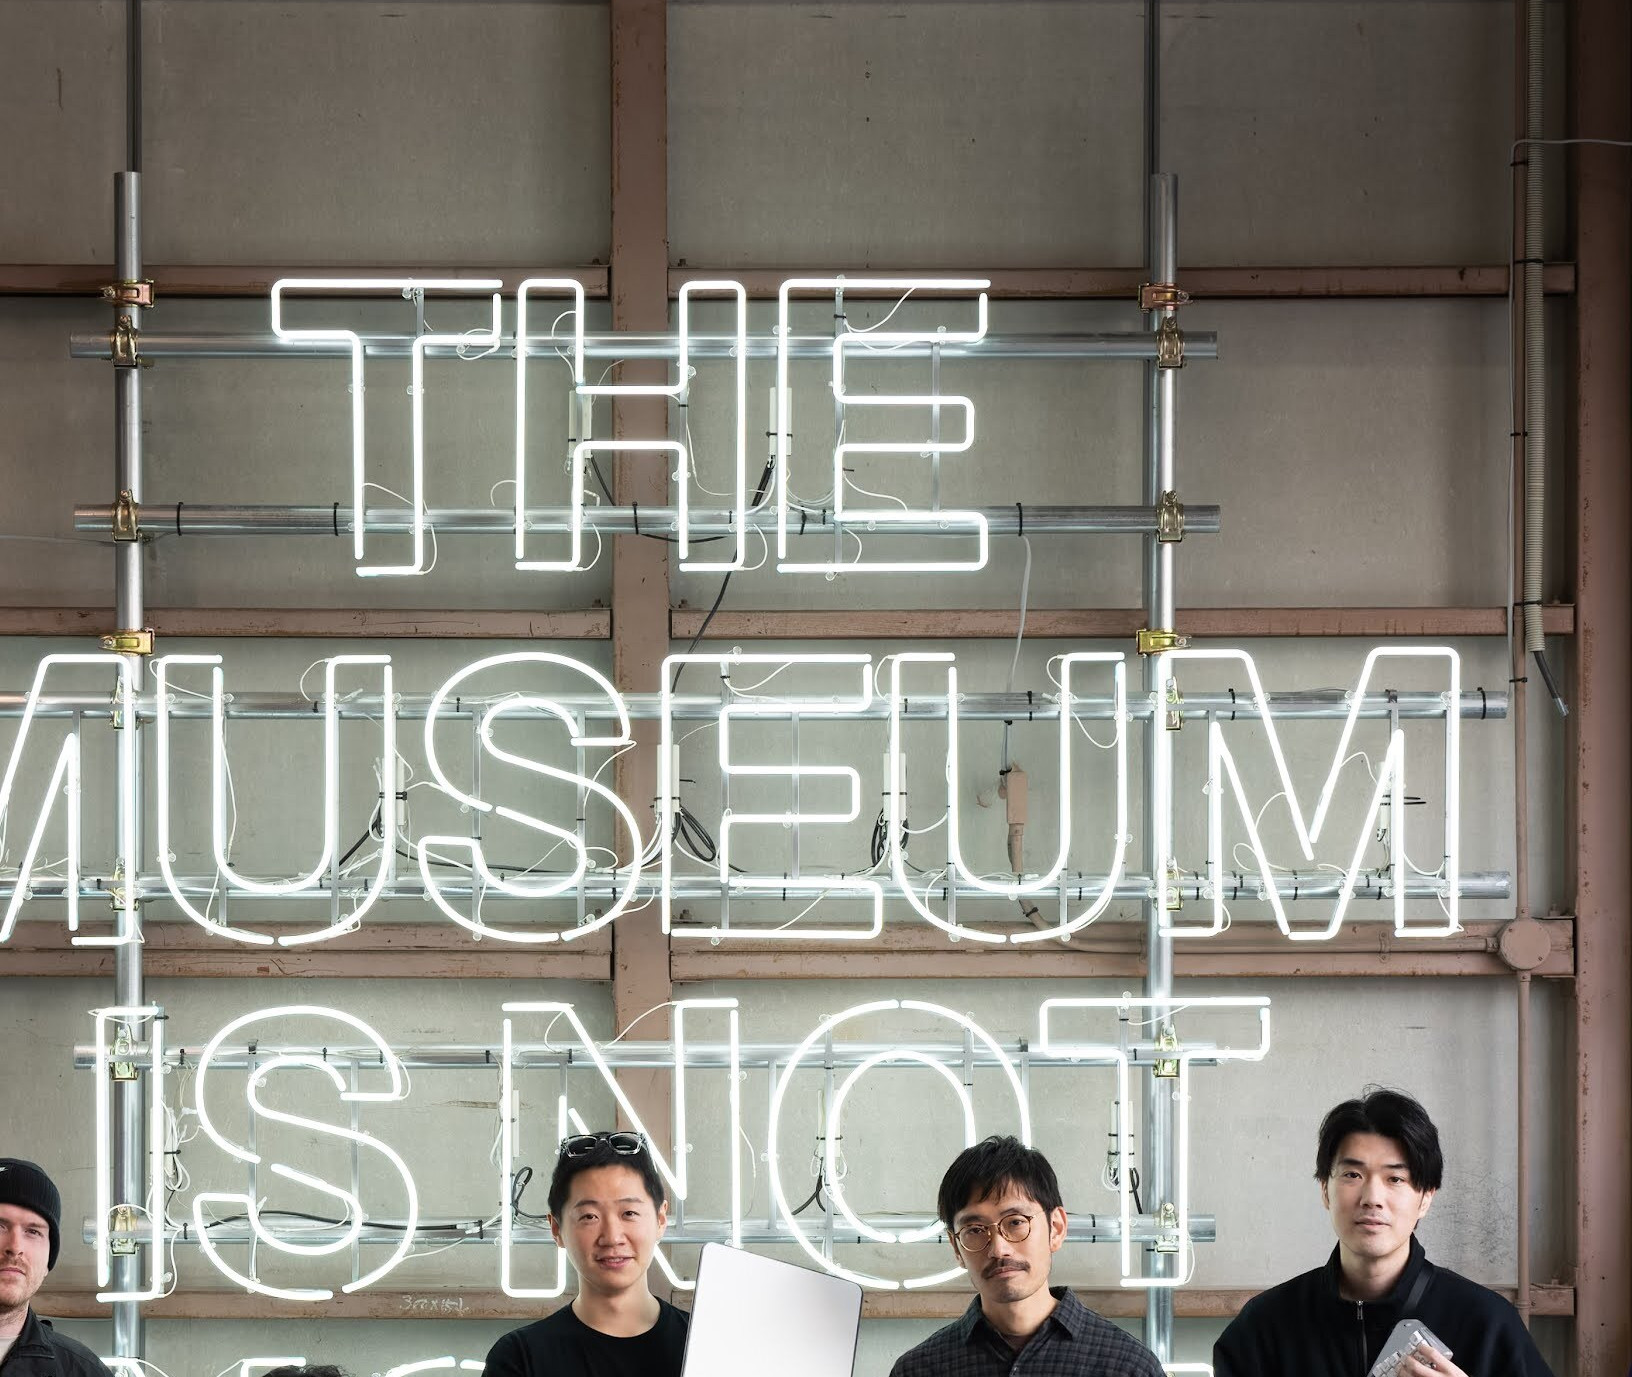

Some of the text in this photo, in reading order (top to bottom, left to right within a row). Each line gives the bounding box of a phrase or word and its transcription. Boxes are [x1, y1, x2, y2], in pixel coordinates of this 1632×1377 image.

[271, 276, 993, 576] THE
[90, 998, 1273, 1302] IS NOT
